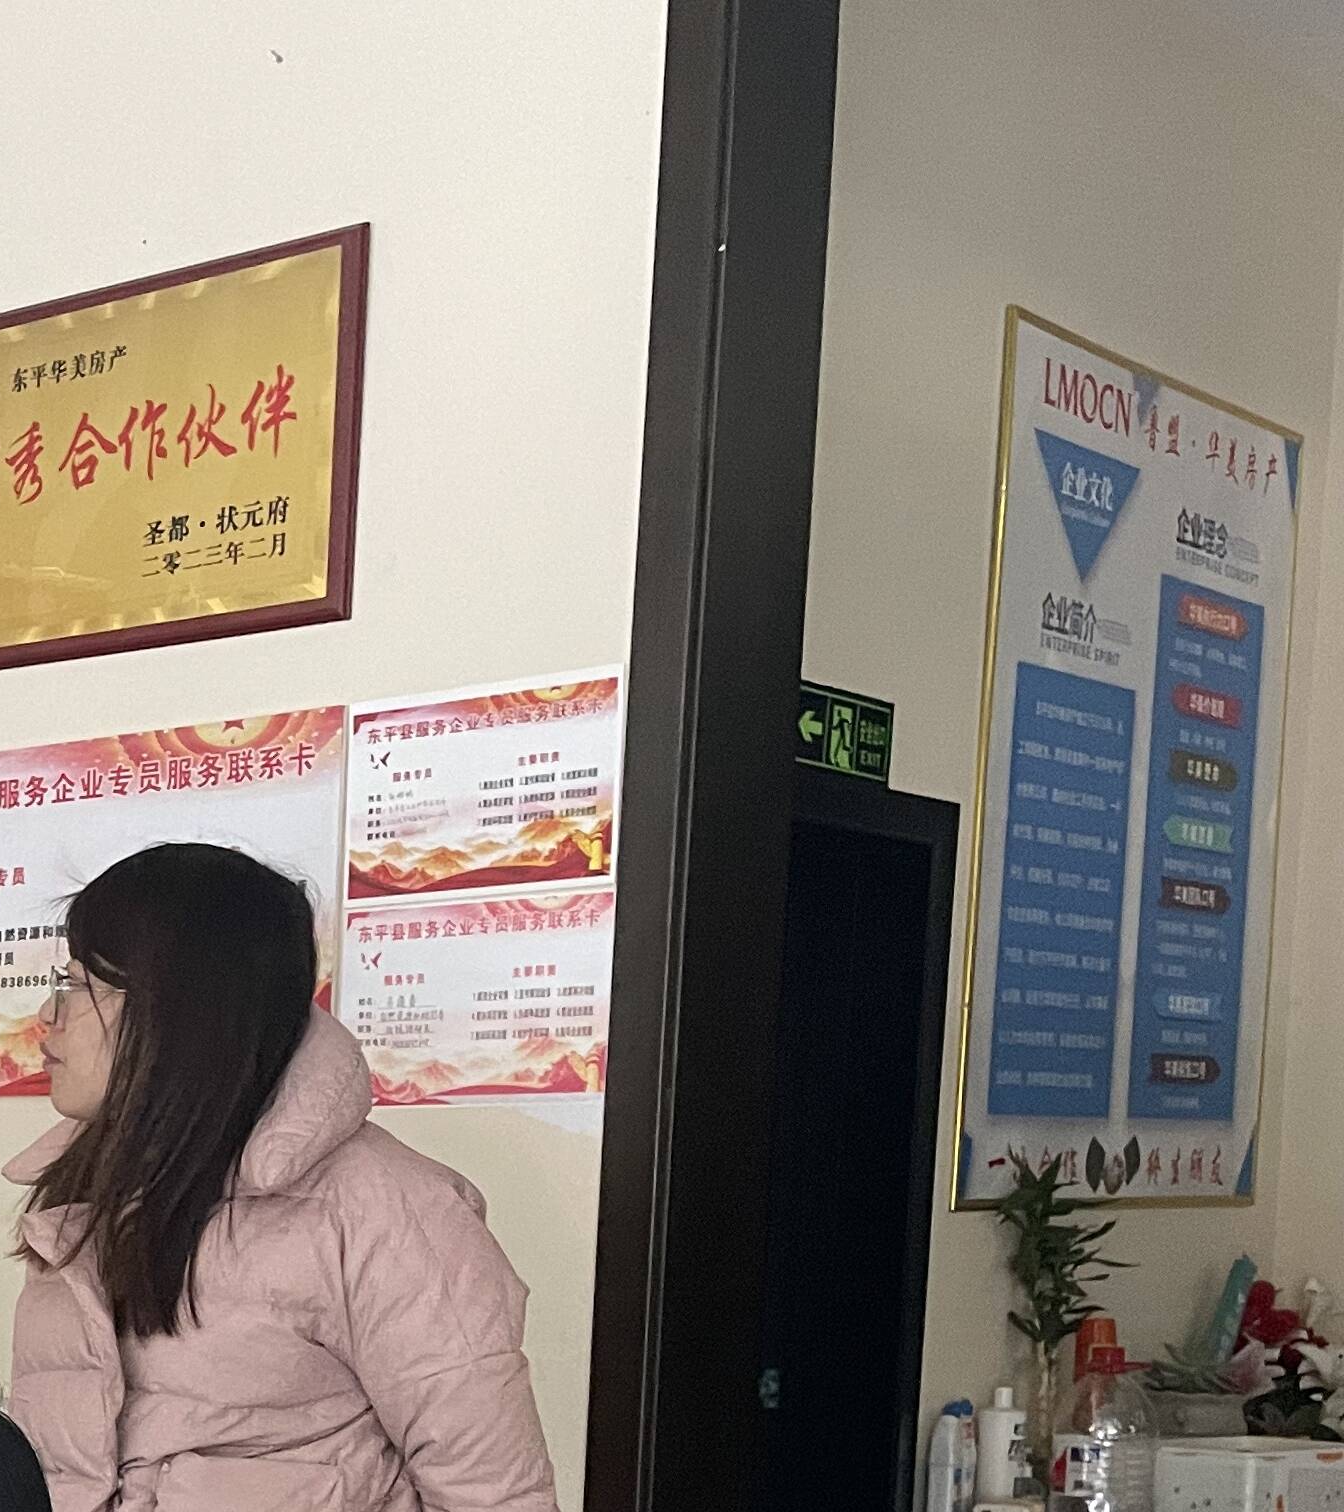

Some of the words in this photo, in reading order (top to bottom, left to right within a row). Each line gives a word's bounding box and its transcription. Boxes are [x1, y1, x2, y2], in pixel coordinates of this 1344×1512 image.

[1042, 356, 1132, 437] LMOCN
[1061, 461, 1113, 511] 企业文化
[1042, 592, 1097, 643] 企业简介
[860, 750, 881, 766] EXIT
[358, 909, 601, 944] 东平县服务企业专员服务联系卡
